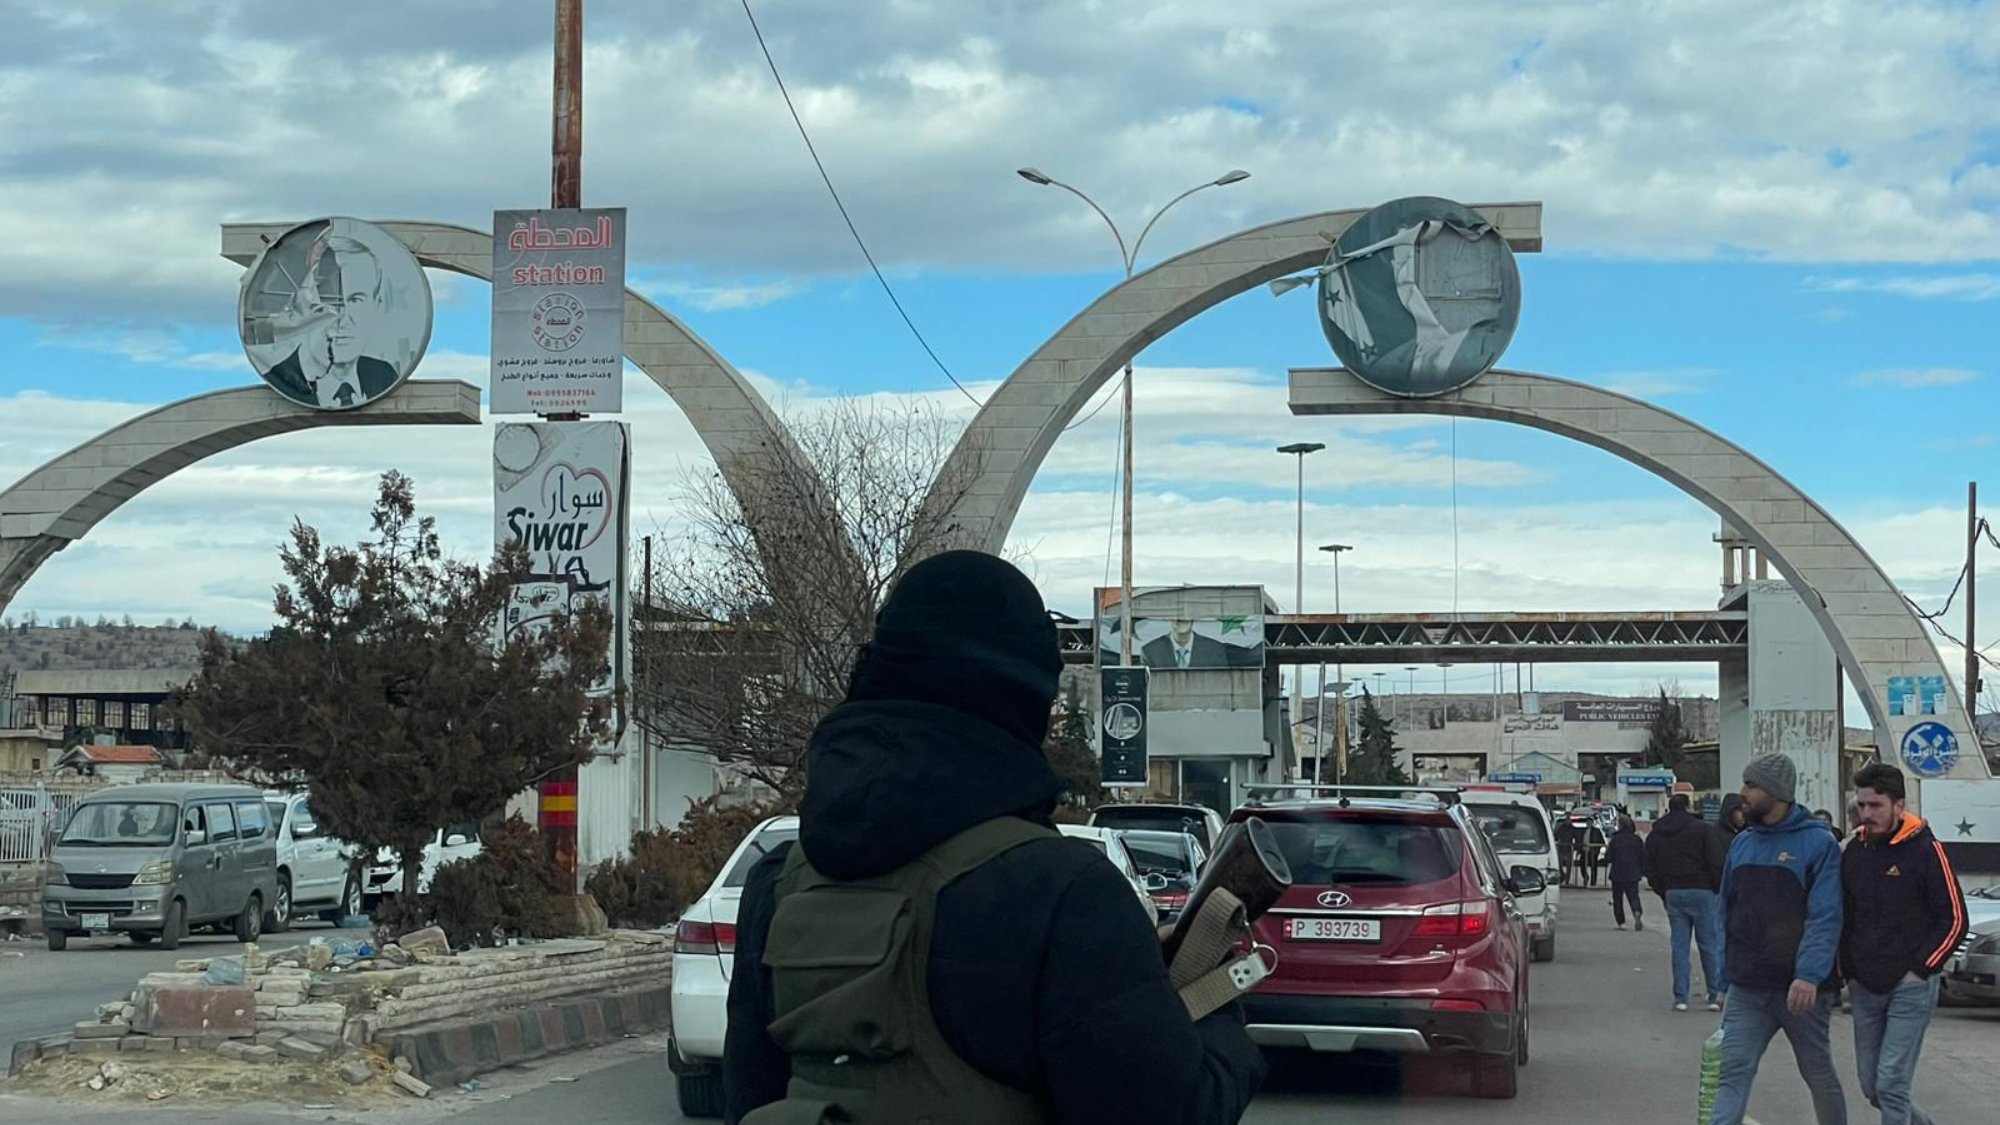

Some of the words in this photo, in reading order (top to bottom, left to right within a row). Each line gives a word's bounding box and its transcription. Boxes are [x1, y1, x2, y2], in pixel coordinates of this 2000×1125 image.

[508, 216, 612, 251] المحطة
[513, 261, 605, 286] station
[547, 472, 603, 519] سوار
[506, 507, 588, 551] Siwar
[1295, 921, 1305, 937] P
[1314, 921, 1370, 937] 393739
